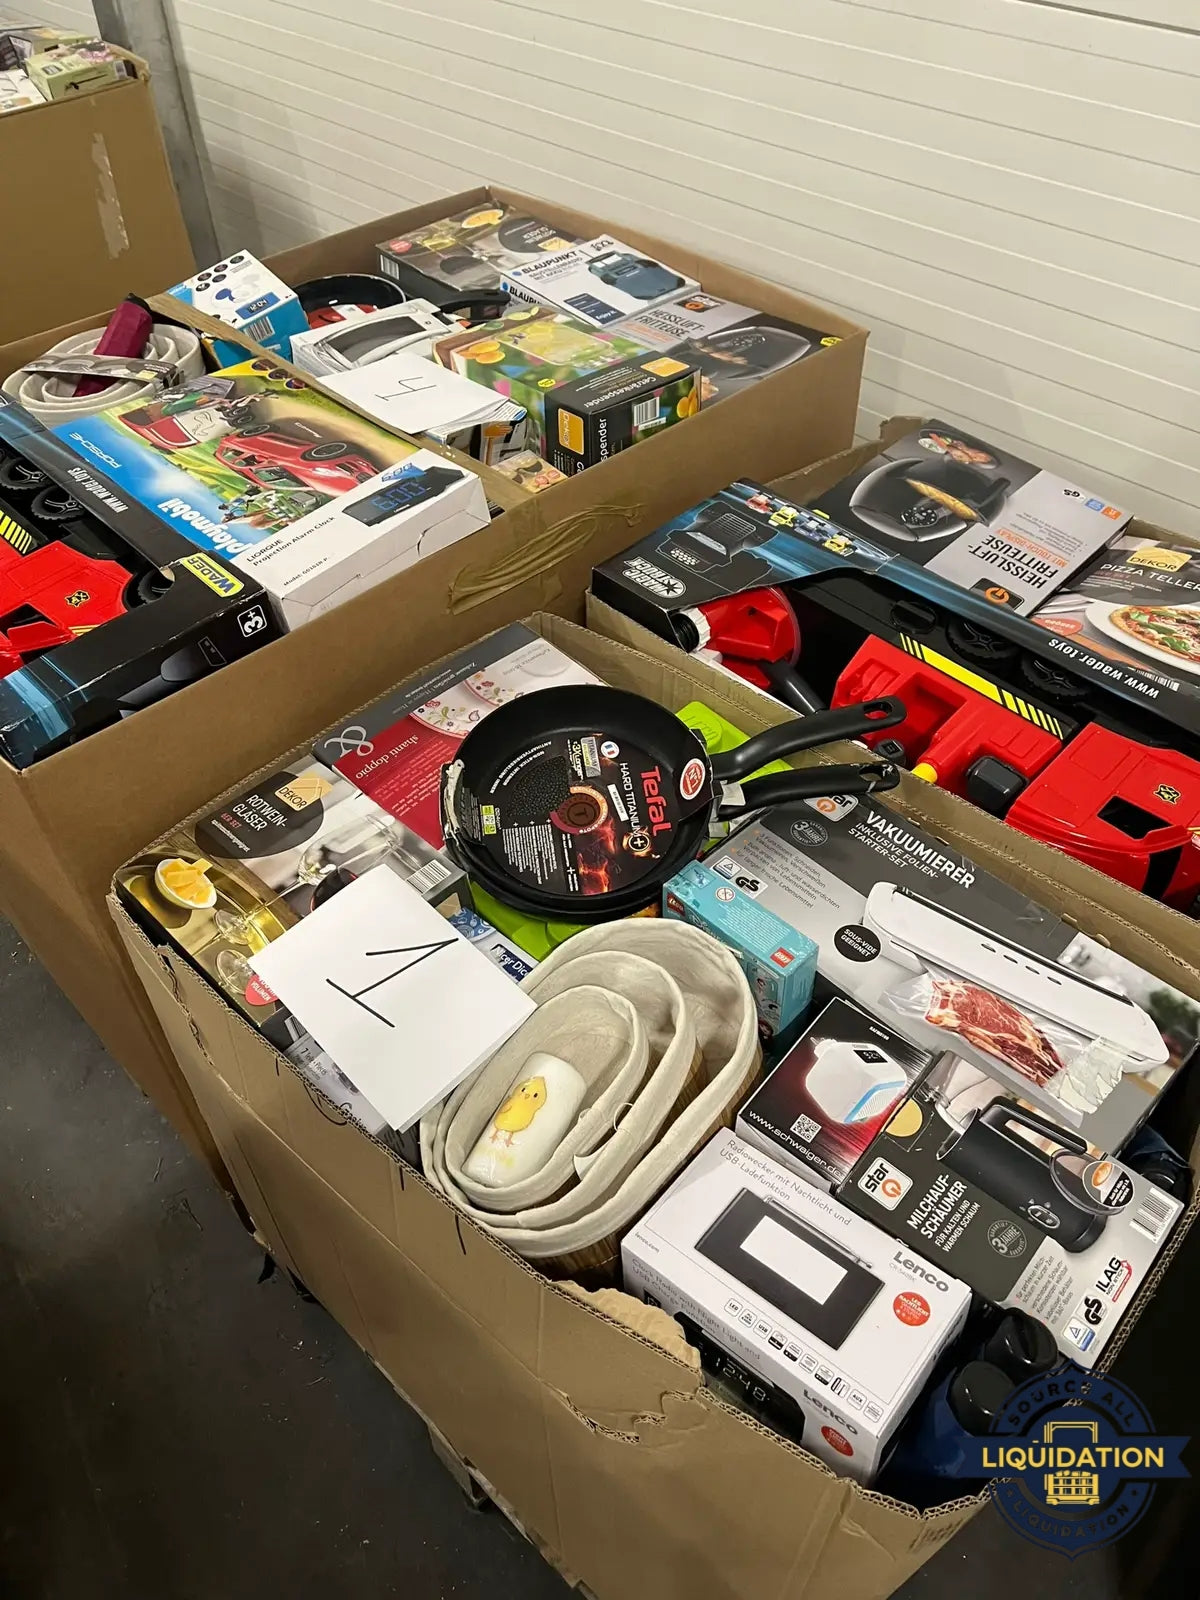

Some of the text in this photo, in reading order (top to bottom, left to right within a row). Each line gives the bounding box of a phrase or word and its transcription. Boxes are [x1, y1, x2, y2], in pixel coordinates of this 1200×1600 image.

[521, 251, 577, 274] BLAUPUNKT
[634, 315, 691, 338] FRITTEUSE
[649, 309, 704, 333] HEISSLUFT-
[584, 377, 656, 408] Getränkespender
[69, 432, 122, 469] PORSCHE
[157, 498, 253, 553] playmobil
[292, 529, 314, 544] Alarm
[186, 556, 233, 593] WADER
[624, 551, 671, 587] TRUCK
[968, 545, 1048, 589] HEISSLUFT-
[982, 535, 1059, 579] FRITTEUSE
[1130, 556, 1177, 571] DEKOR
[623, 563, 666, 597] MAGIC
[1100, 563, 1143, 576] PIZZA
[1150, 572, 1200, 590] TELLER
[1048, 638, 1159, 698] www.wader.toys
[353, 733, 422, 782] shanti doppio
[620, 762, 633, 791] HARD
[246, 794, 288, 827] ROTWEIN-
[279, 786, 307, 808] DEKOR
[641, 765, 672, 837] Tefal
[233, 803, 267, 831] GLÄSER
[793, 818, 810, 834] 3
[801, 824, 826, 846] JAHRE
[848, 828, 909, 869] STARTER-SET
[855, 822, 902, 857] INKLUSIVE
[902, 854, 939, 880] FOLIEN-
[865, 809, 975, 888] VAKUUMIERER
[735, 876, 760, 892] GS
[840, 935, 872, 957] GEEIGNET
[844, 928, 877, 954] SOUS-VIDE
[750, 1111, 846, 1178] www.schwaiger.de
[717, 1148, 794, 1201] USB-Ladefunktion
[726, 1139, 852, 1226] Radiowecker mit Nachtlicht und
[865, 1161, 891, 1194] star
[906, 1170, 953, 1230] MILCHAUF-
[918, 1177, 967, 1240] SCHÄUMER
[933, 1199, 971, 1247] FÜR KALTEN UND
[942, 1202, 981, 1253] WARMEN SCHAUM
[990, 1223, 1021, 1255] 3 JAHRE
[893, 1251, 949, 1293] Lenco
[1095, 1256, 1121, 1293] ILAG
[1105, 1281, 1115, 1296] NON
[1083, 1295, 1104, 1326] GS
[803, 1390, 858, 1436] Lenco
